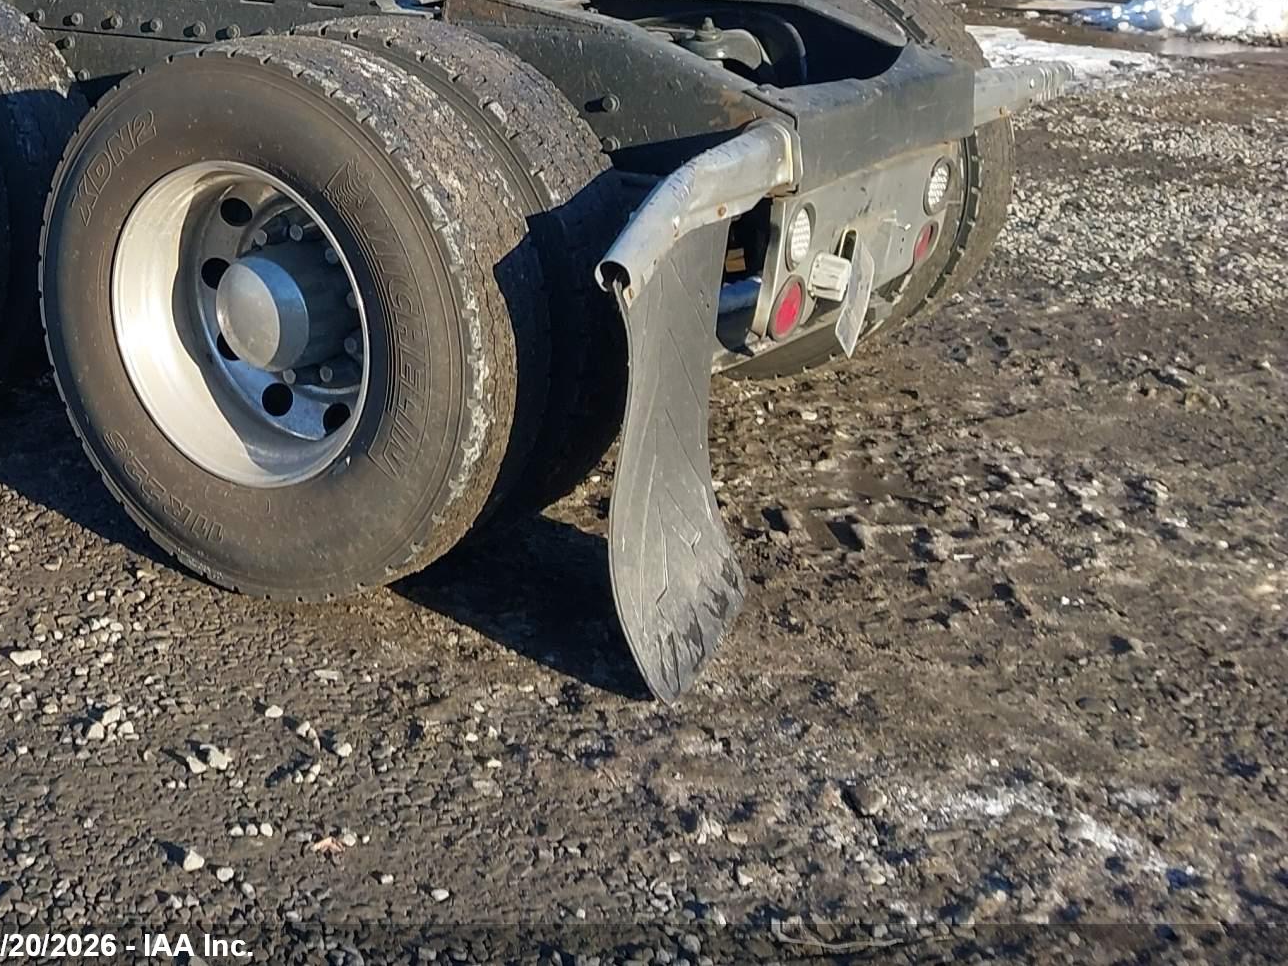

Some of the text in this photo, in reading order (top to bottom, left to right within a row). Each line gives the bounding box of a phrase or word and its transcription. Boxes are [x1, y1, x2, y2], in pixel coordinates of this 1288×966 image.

[71, 109, 156, 227] XDN2
[353, 202, 427, 478] MICHELIN
[103, 430, 224, 544] 11R22.5
